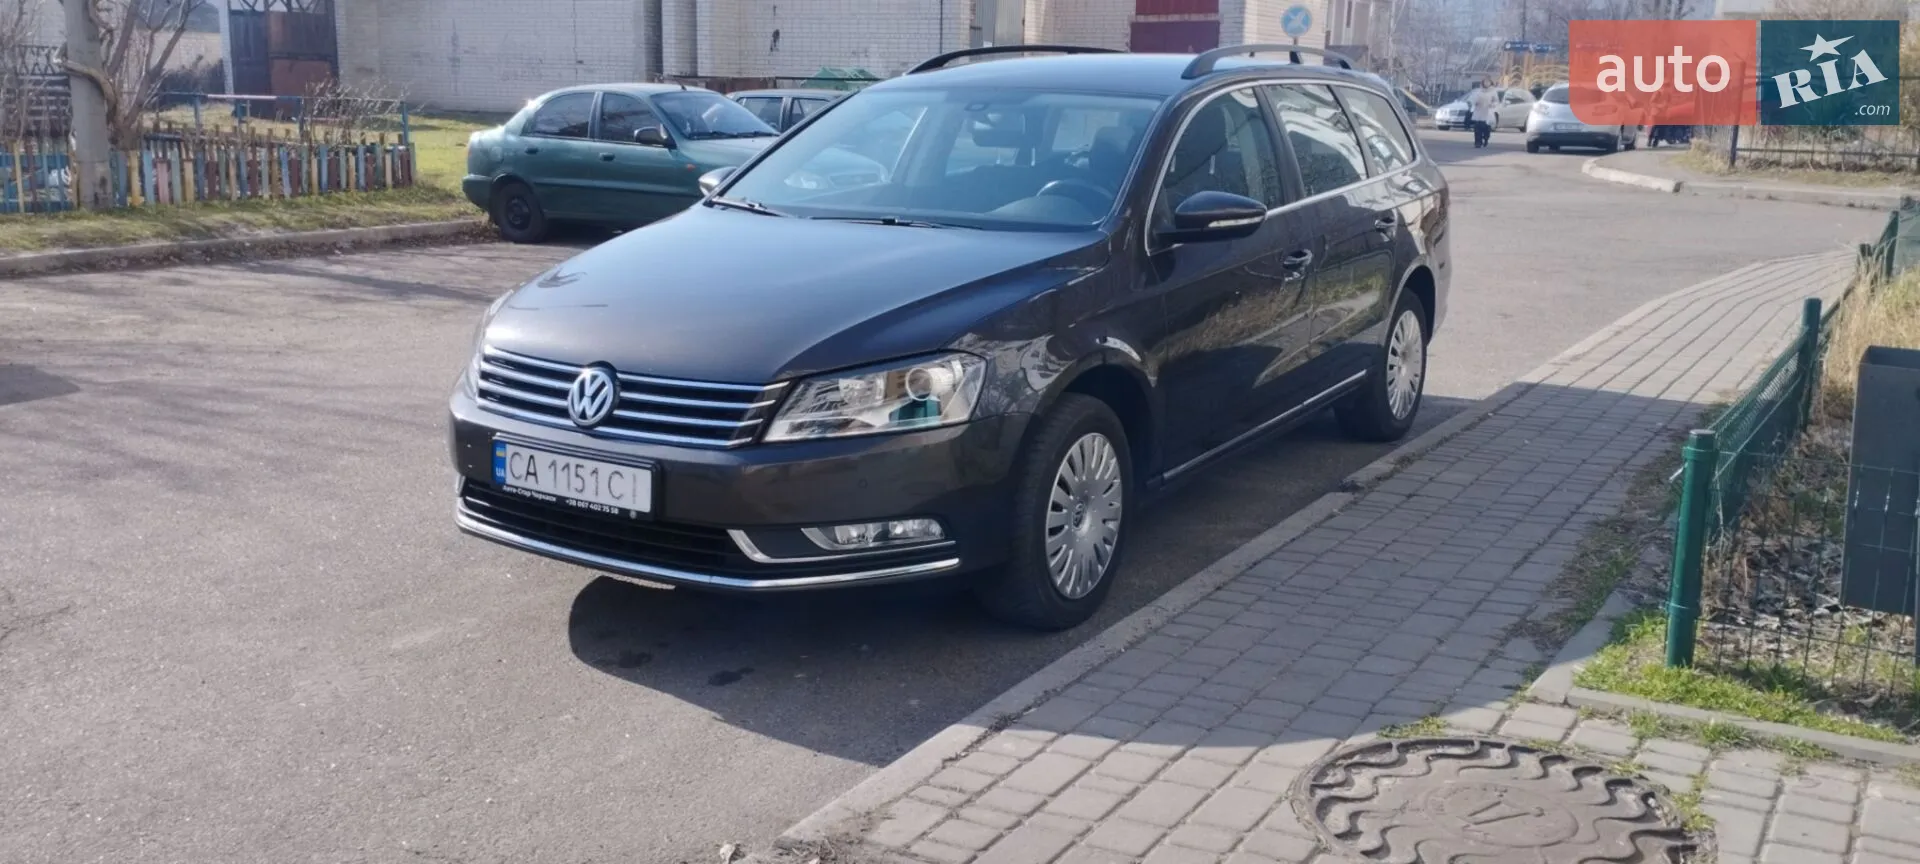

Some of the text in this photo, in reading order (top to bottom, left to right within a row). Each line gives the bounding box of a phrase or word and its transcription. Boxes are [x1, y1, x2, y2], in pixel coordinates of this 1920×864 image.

[569, 369, 611, 424] VW
[495, 466, 505, 478] UA
[509, 451, 539, 485] CA
[548, 459, 600, 497] 1151
